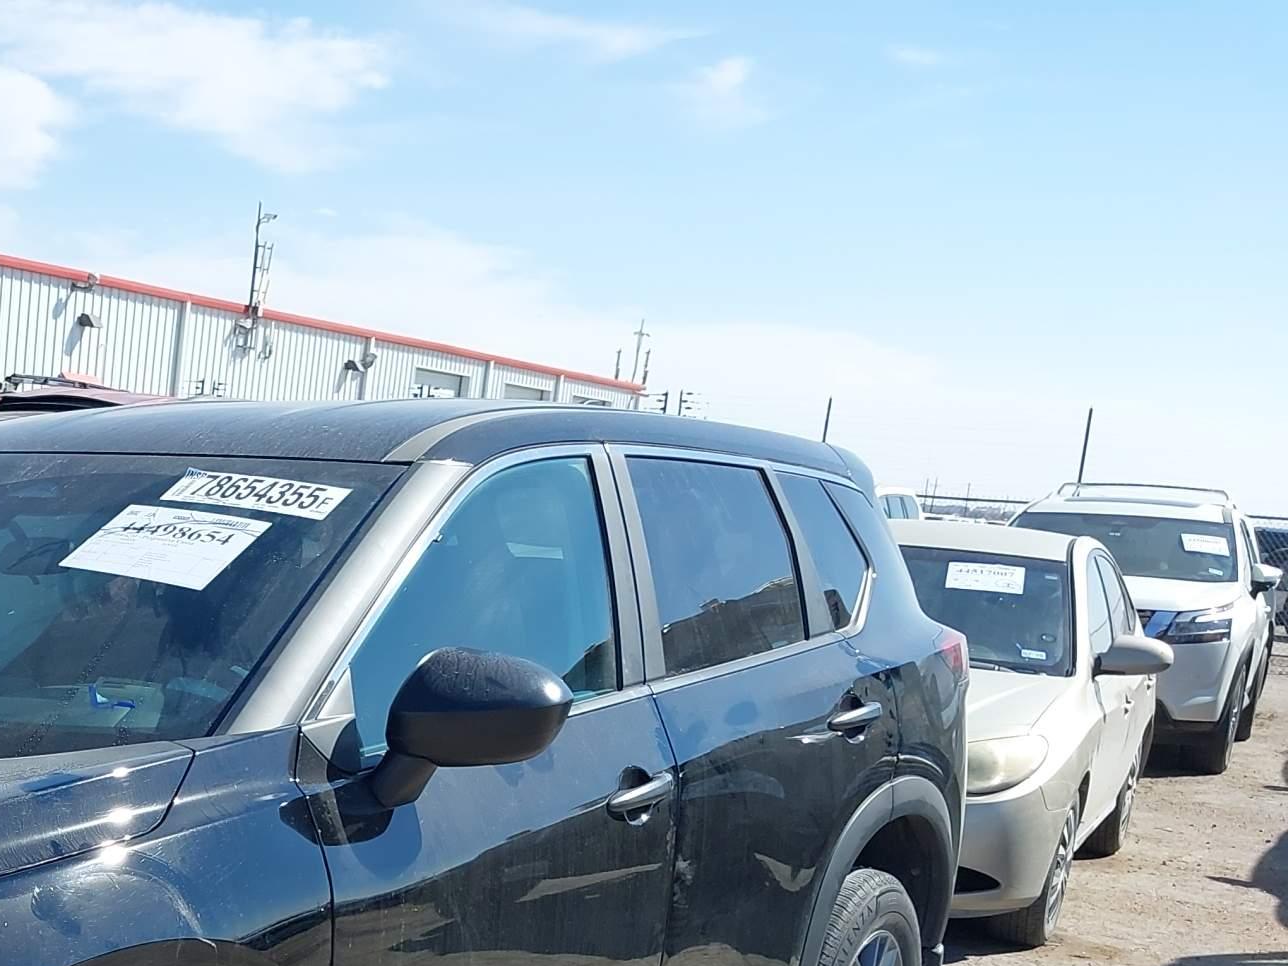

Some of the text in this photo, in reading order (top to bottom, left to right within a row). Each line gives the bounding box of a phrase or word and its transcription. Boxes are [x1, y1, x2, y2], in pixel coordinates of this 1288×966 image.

[191, 474, 328, 510] 78654355
[314, 497, 334, 510] F
[122, 521, 236, 546] 44498654
